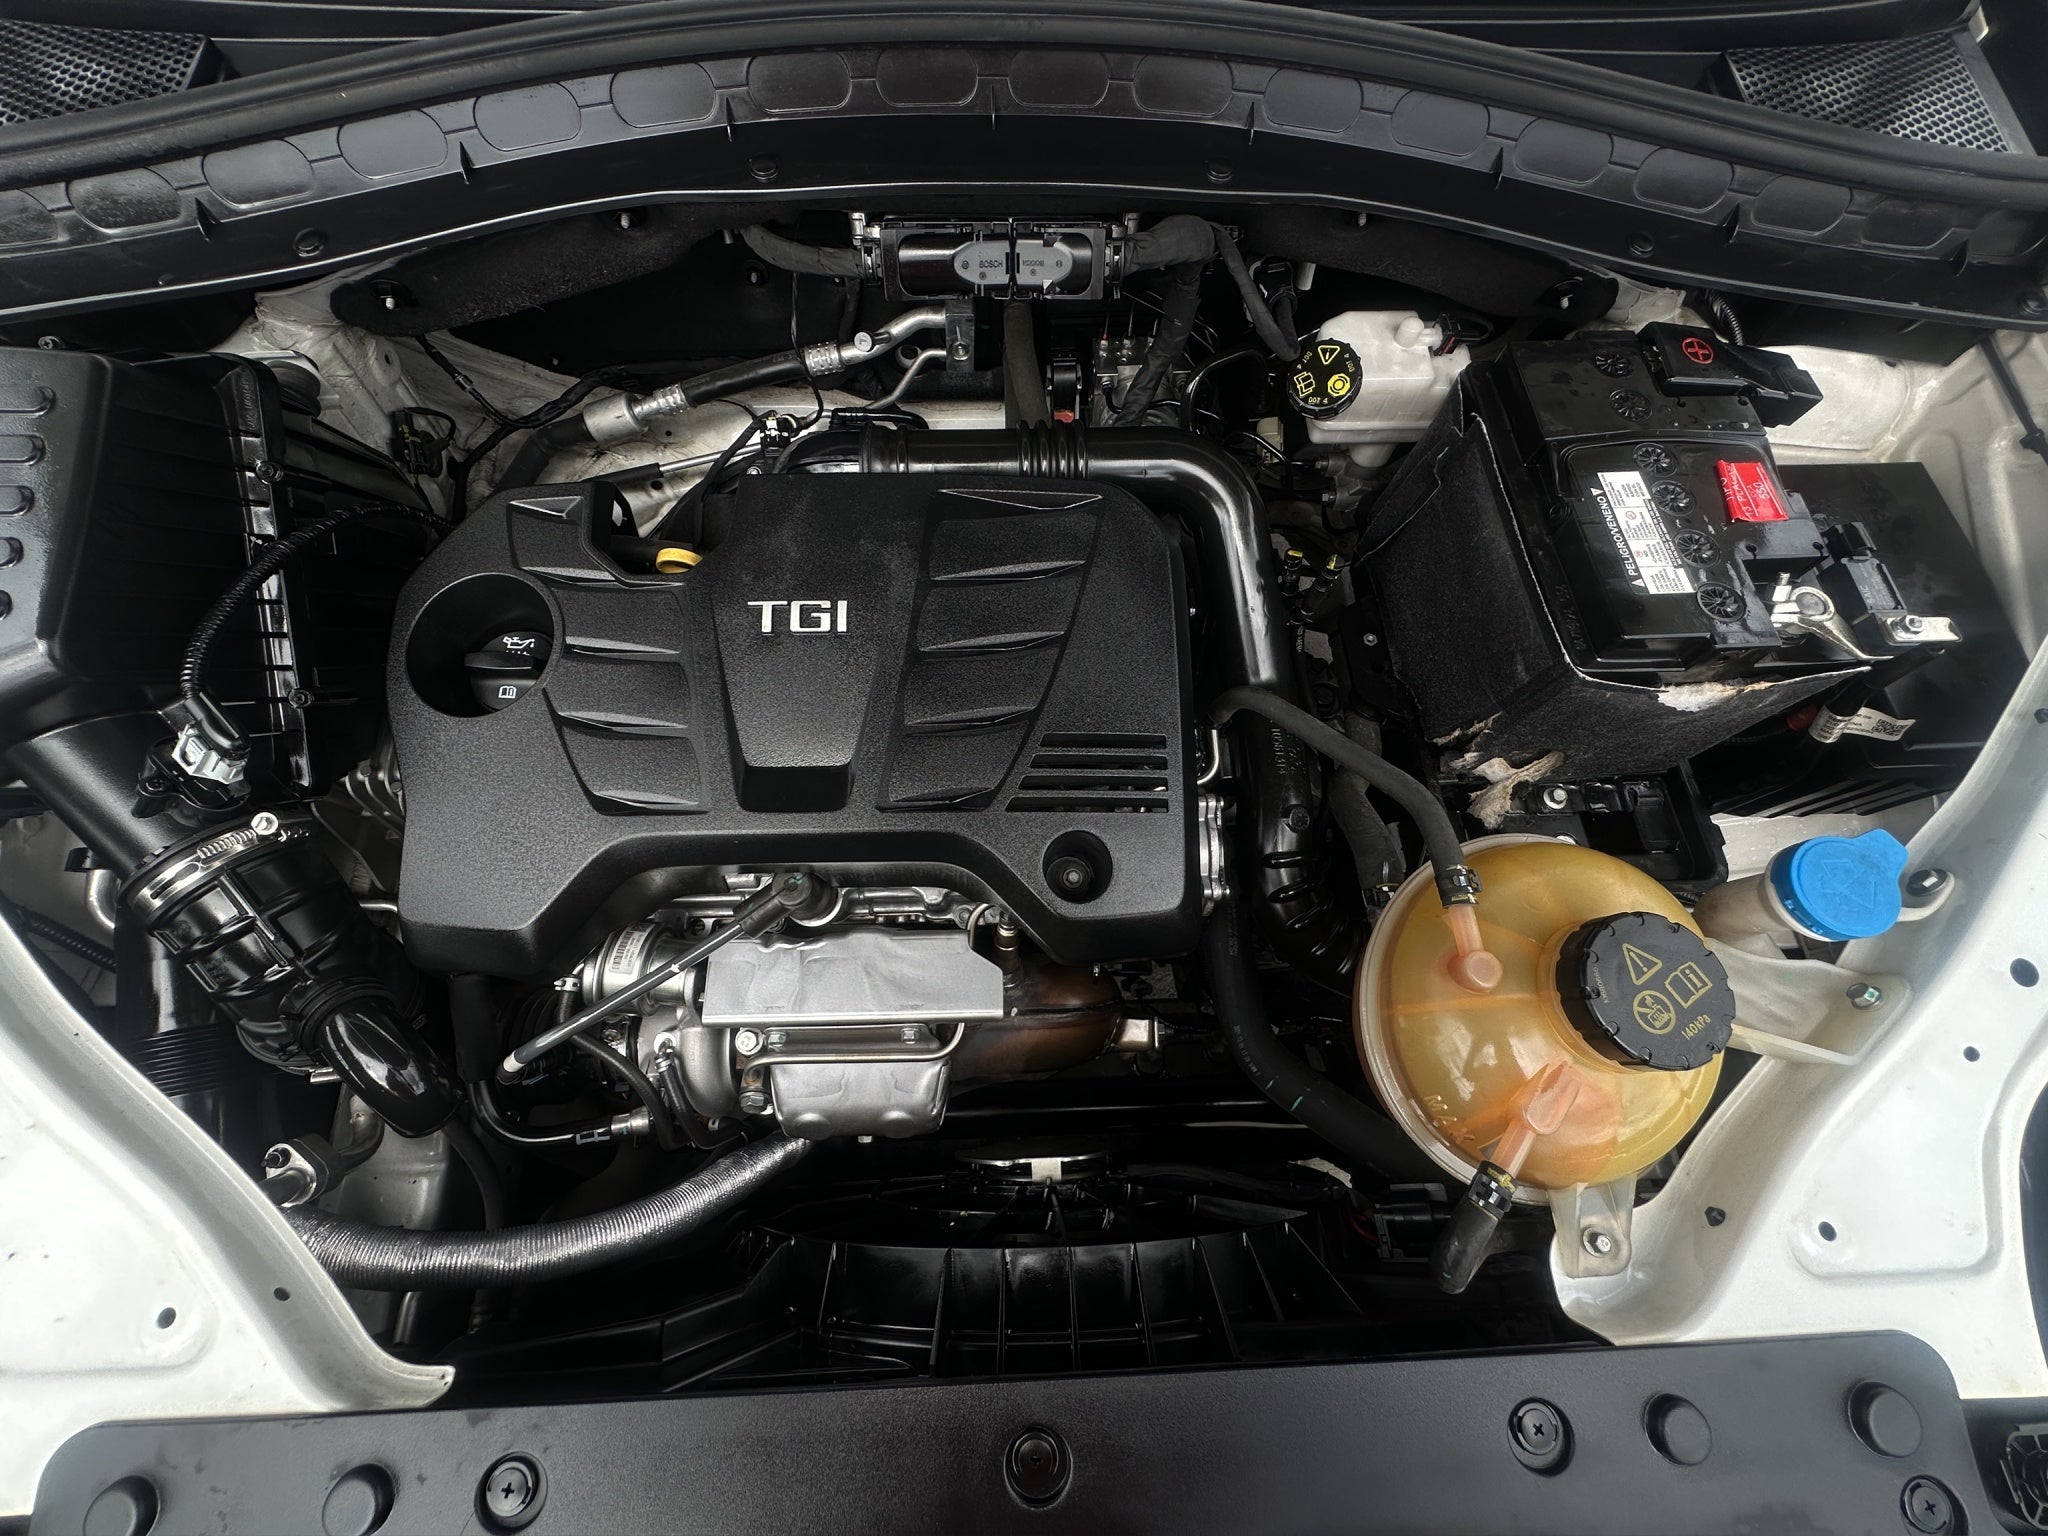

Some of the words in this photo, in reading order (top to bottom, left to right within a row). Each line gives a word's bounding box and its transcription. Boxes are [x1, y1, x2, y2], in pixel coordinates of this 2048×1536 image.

[979, 260, 1003, 268] BOSCH
[1753, 482, 1770, 500] 550
[1597, 495, 1639, 577] PELIGRO/VENENO
[747, 600, 848, 633] TGI
[1681, 1013, 1711, 1041] 140kPa
